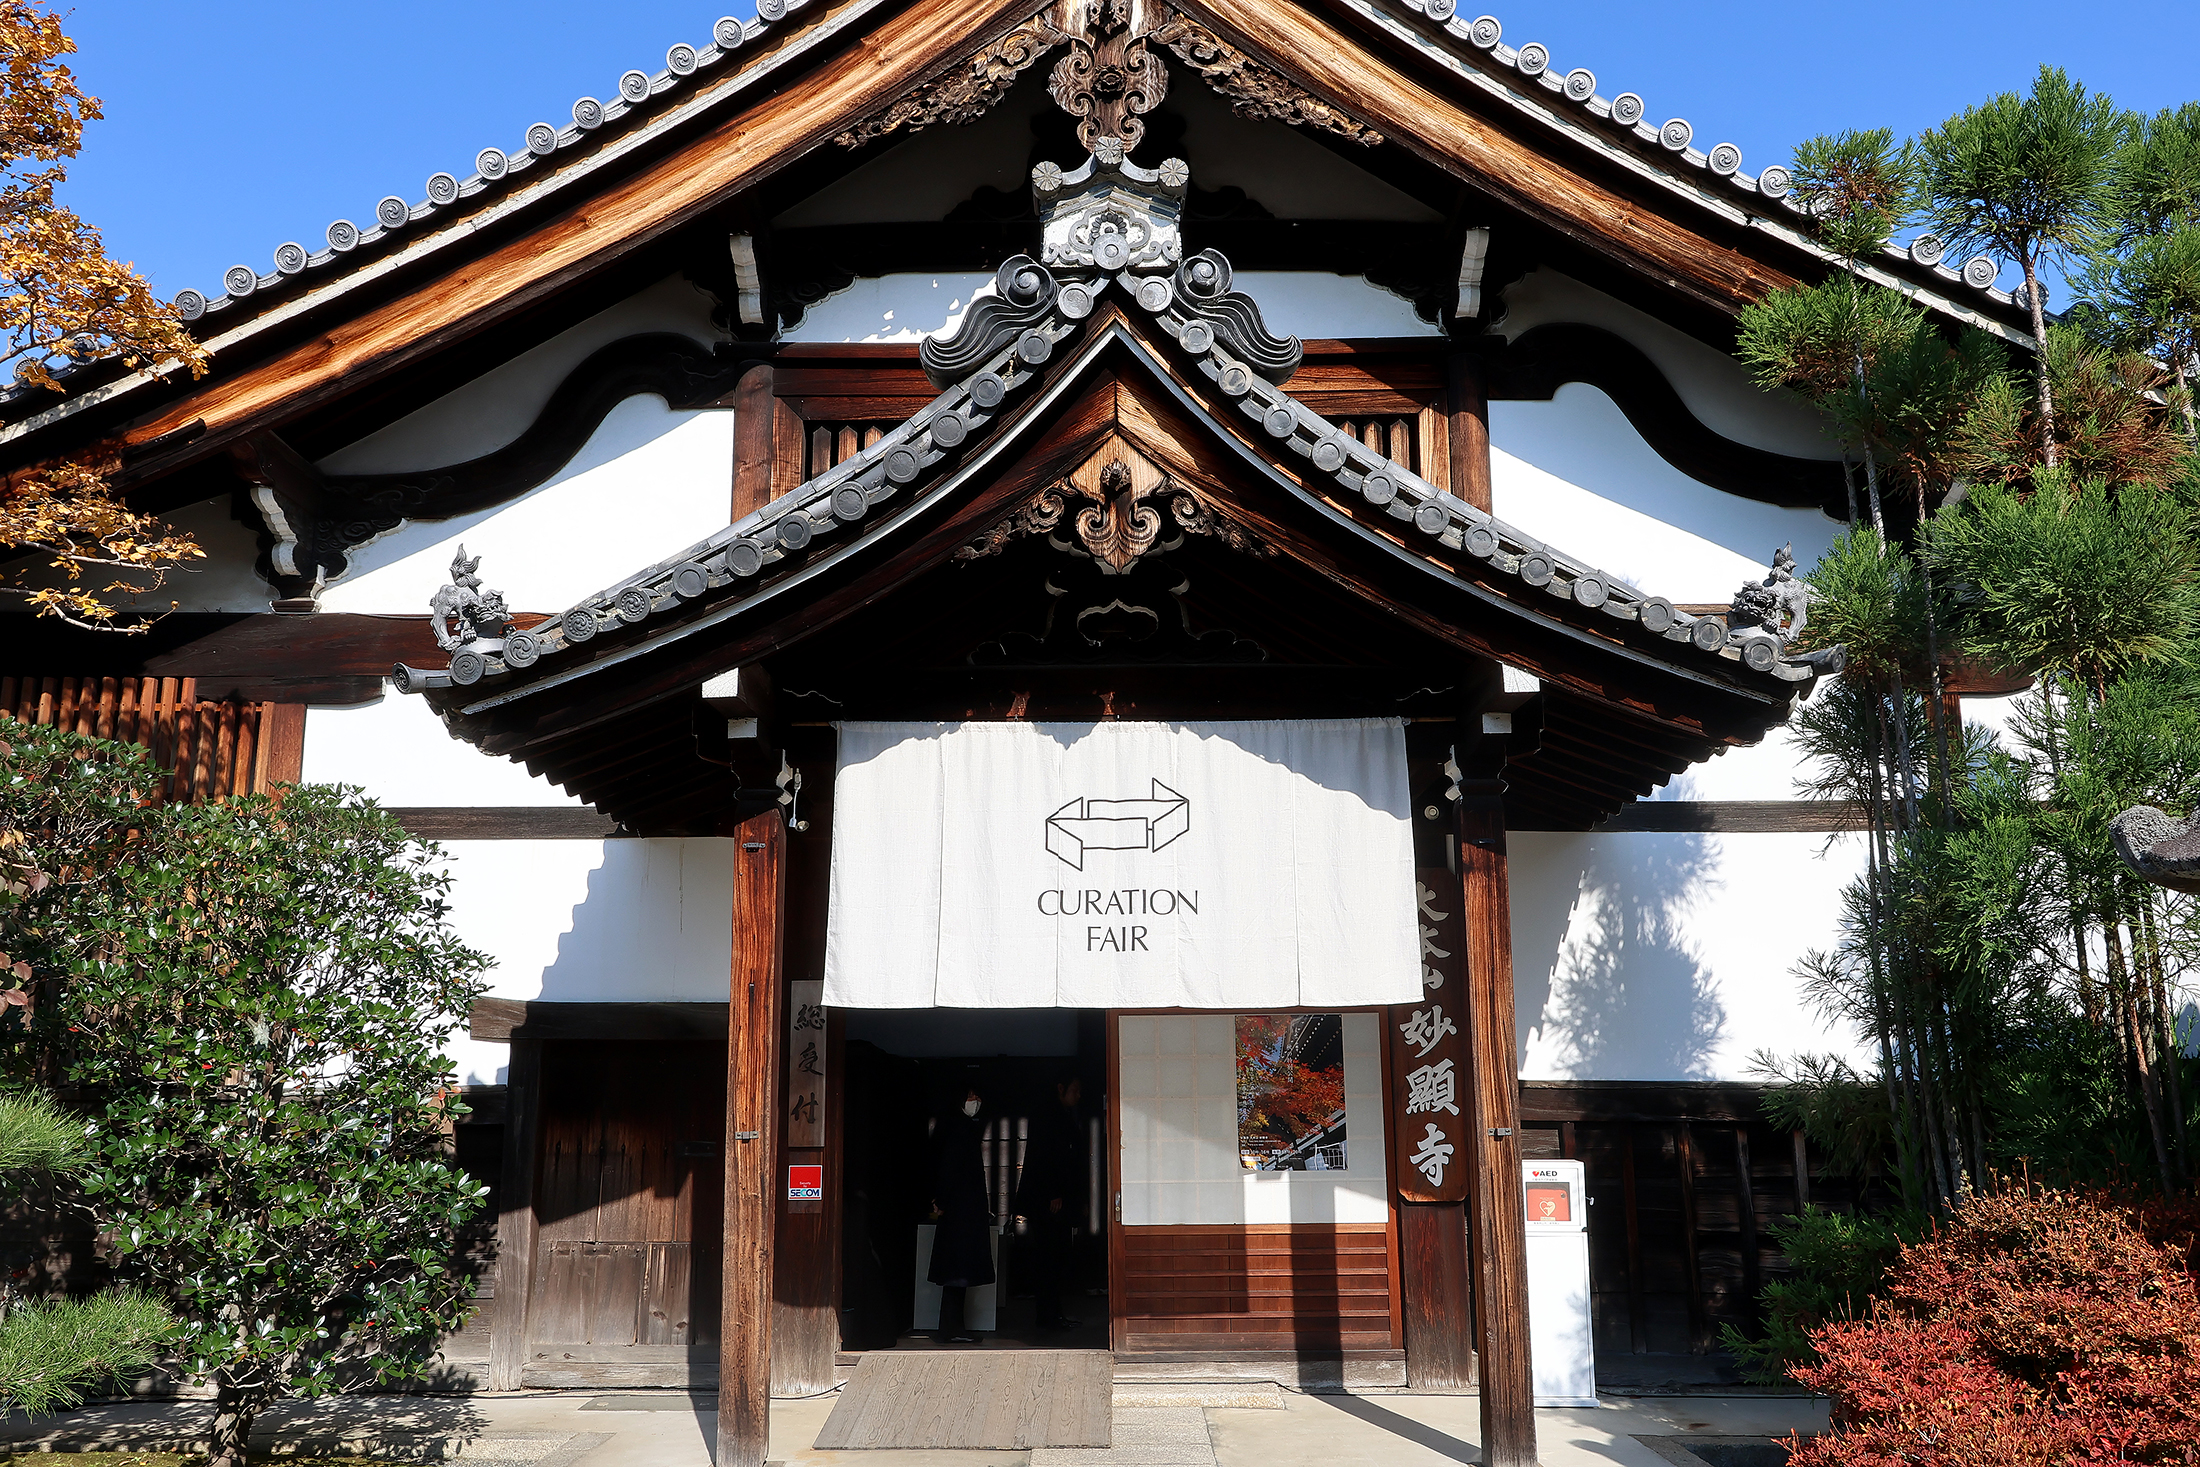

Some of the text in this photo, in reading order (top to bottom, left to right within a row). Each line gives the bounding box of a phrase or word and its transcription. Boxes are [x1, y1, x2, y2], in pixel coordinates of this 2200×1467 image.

[1037, 888, 1199, 916] CURATION
[1087, 925, 1150, 952] FAIR
[790, 1003, 826, 1124] 総受付
[790, 1188, 820, 1197] SECOM
